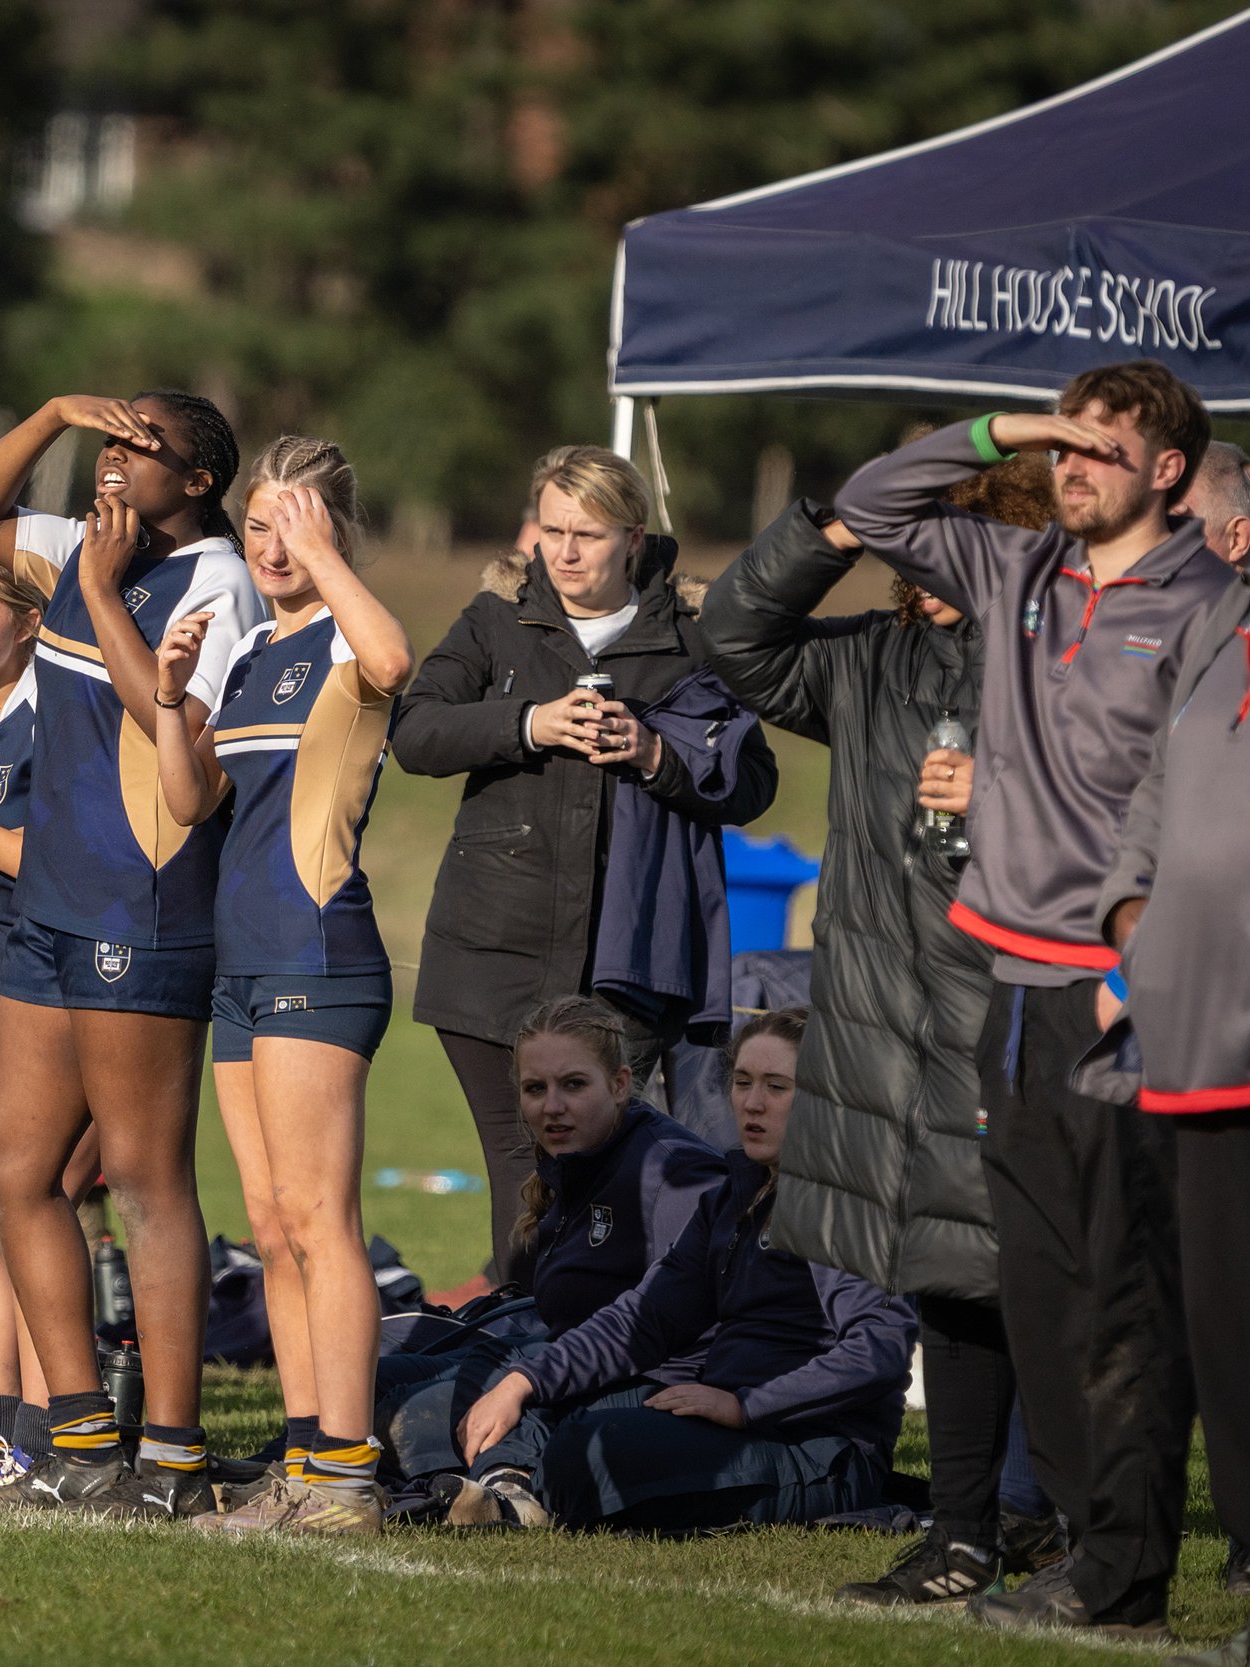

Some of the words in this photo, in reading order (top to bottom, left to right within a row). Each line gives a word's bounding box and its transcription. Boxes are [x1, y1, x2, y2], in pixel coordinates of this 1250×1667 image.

[926, 258, 988, 331] HILL
[991, 264, 1093, 339] HOUSE
[1097, 269, 1223, 351] SCHOOL
